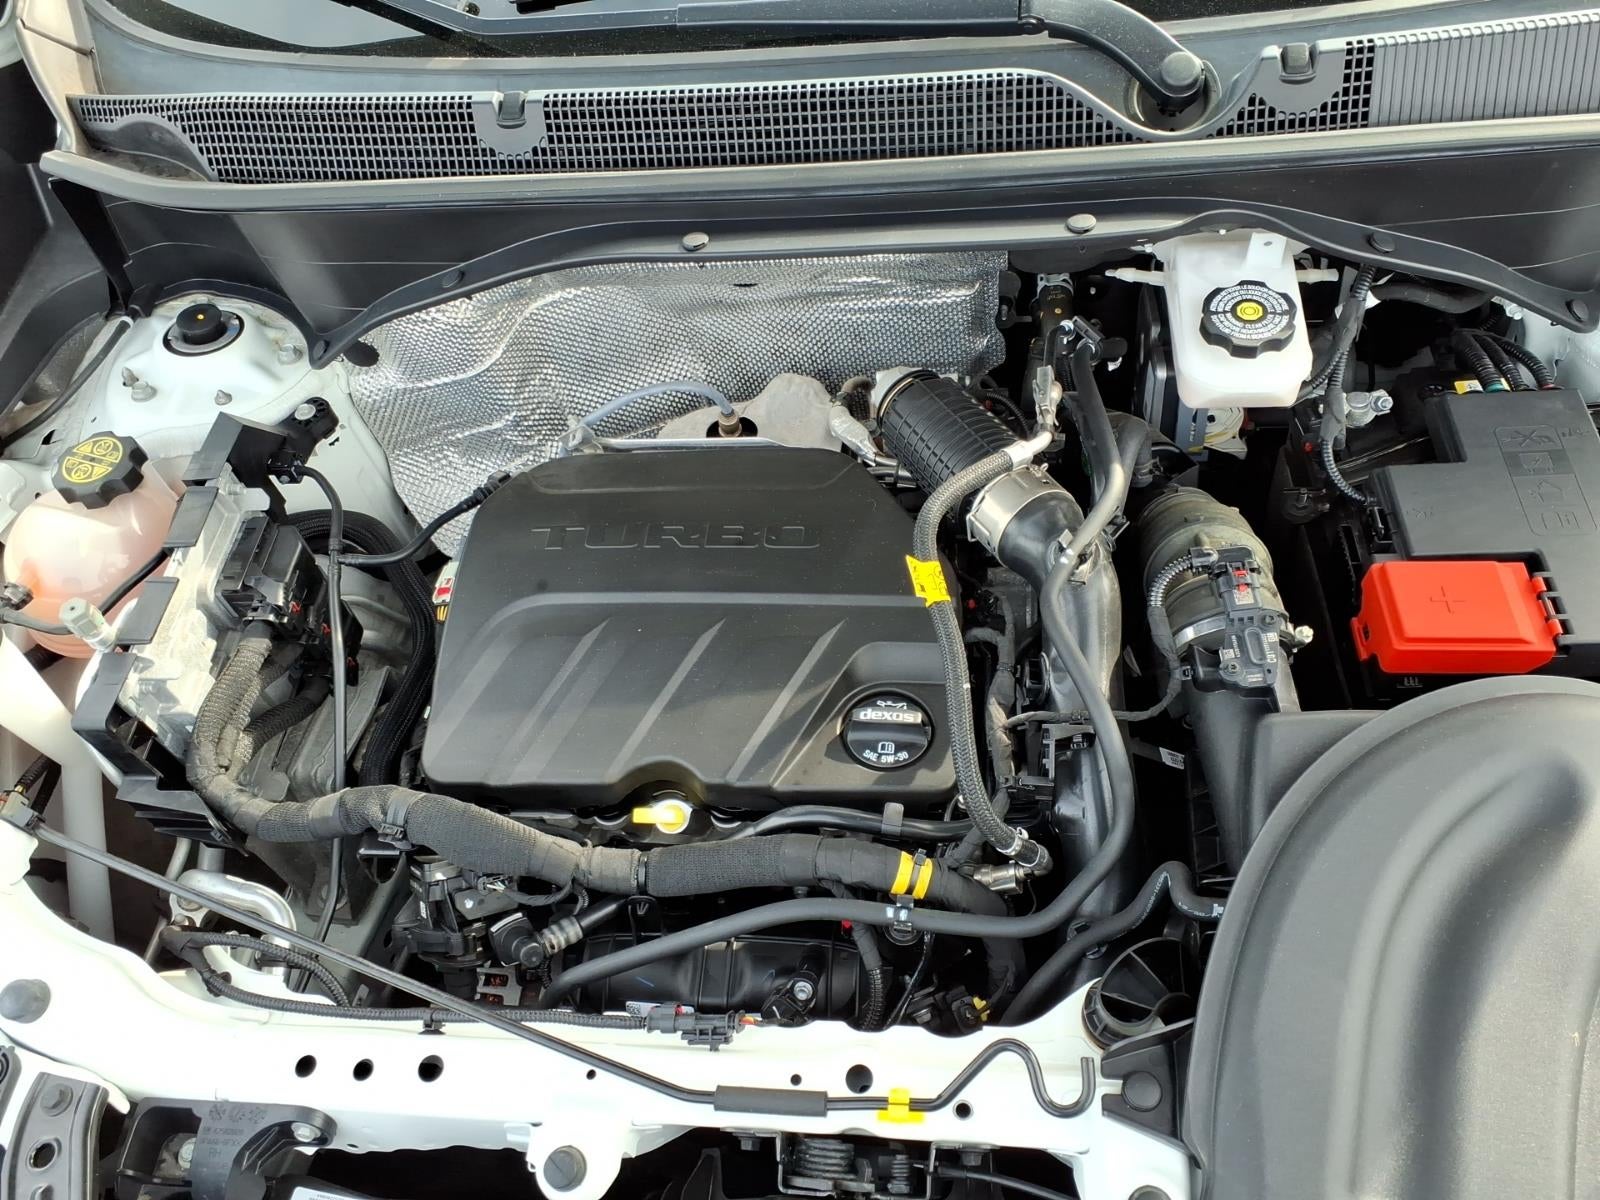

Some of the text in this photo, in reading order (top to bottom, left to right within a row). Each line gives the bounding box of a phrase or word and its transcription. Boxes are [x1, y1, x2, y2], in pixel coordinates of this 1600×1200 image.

[530, 522, 821, 550] TURBO
[860, 709, 915, 722] dexos
[863, 749, 909, 763] SAE 5W-30
